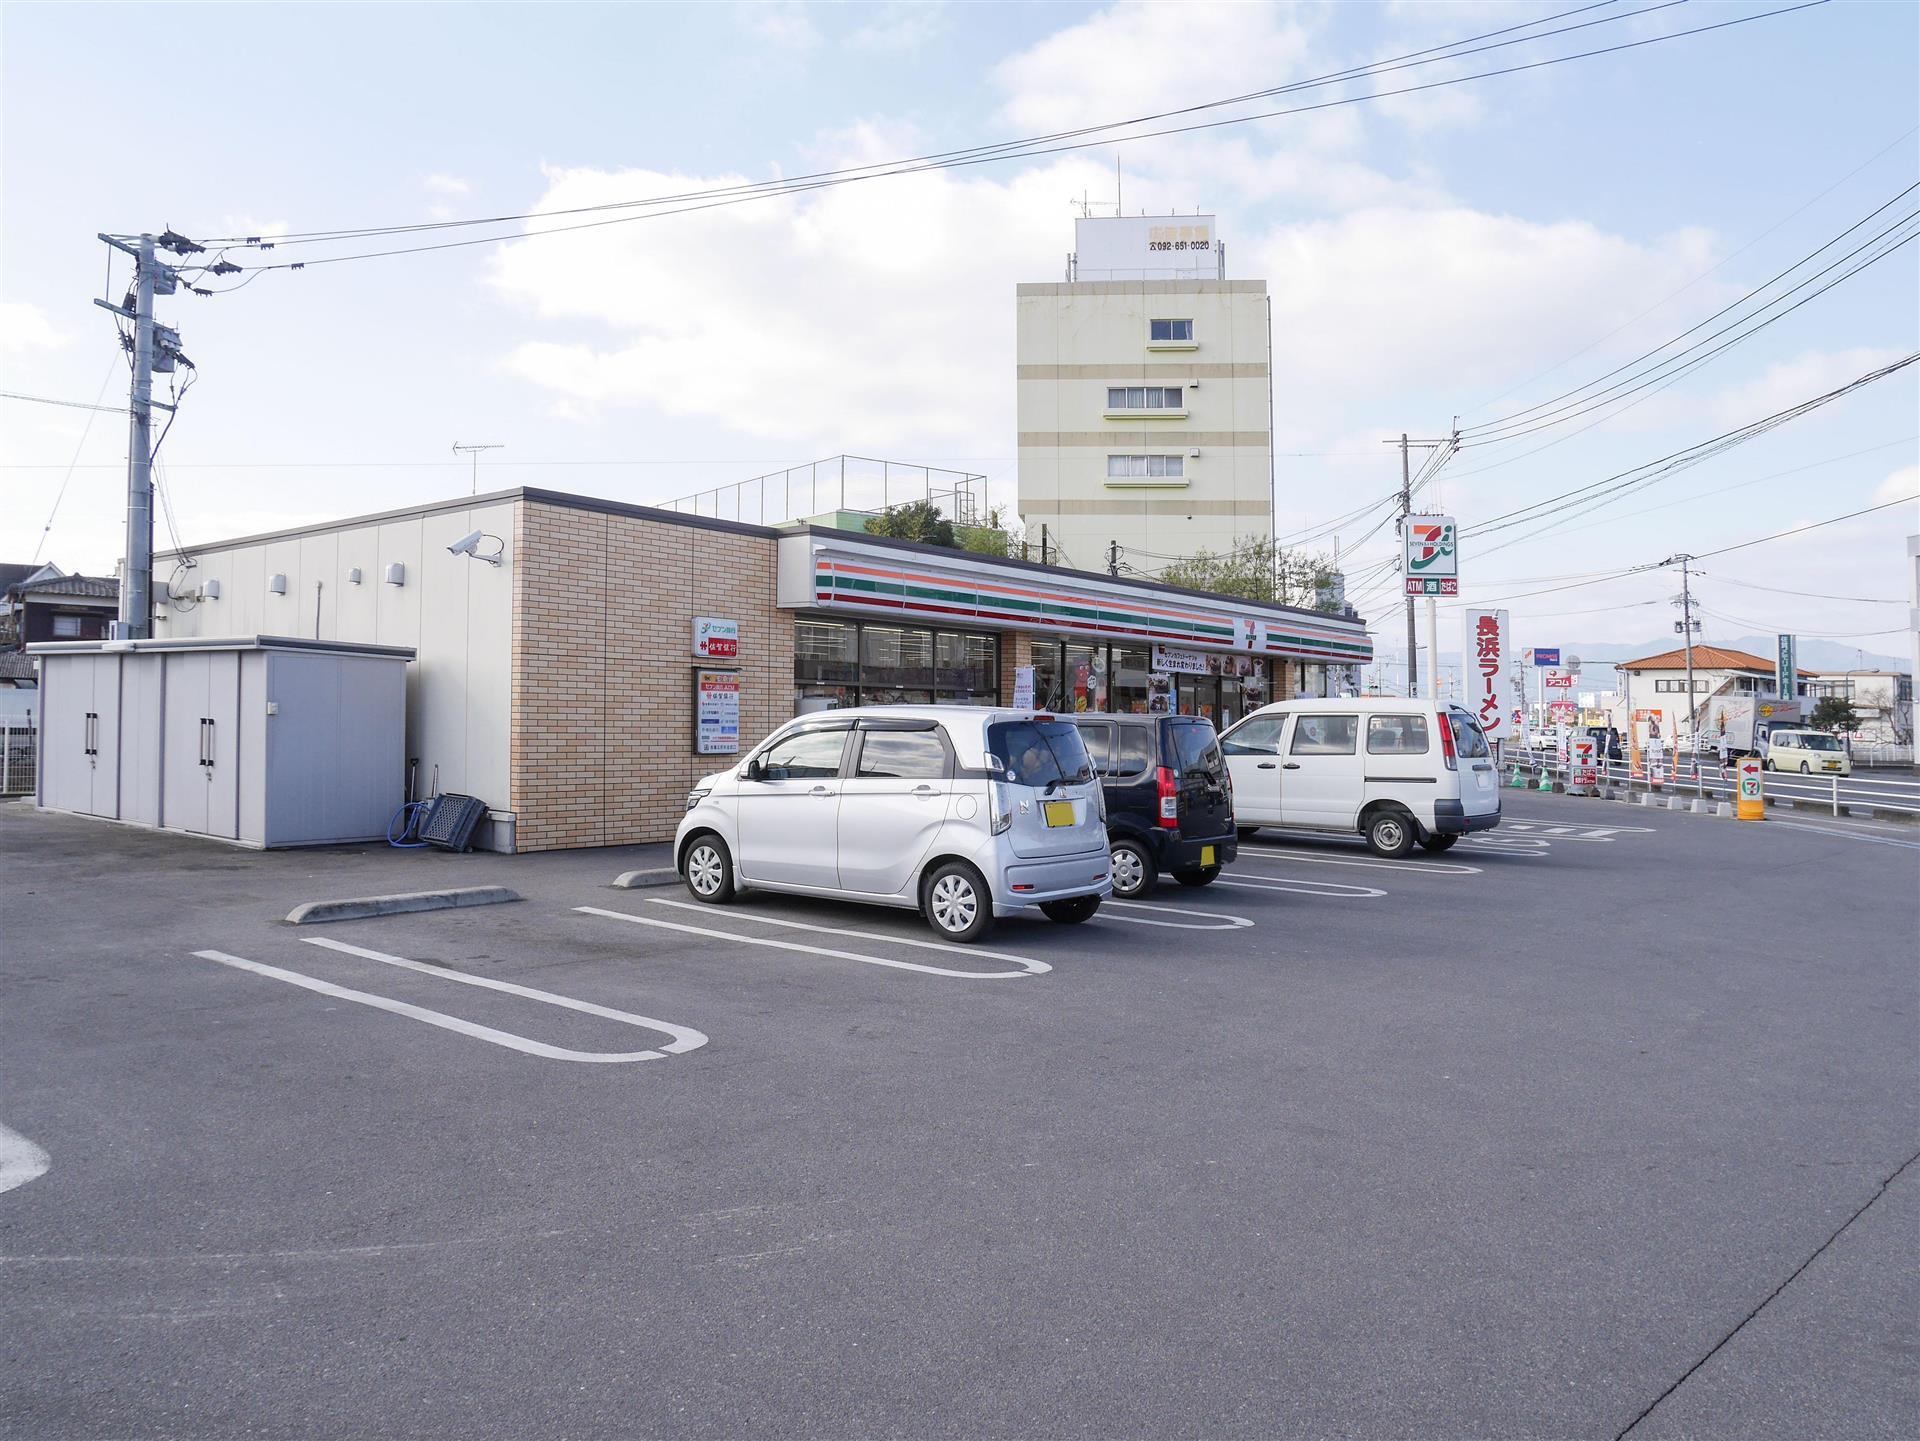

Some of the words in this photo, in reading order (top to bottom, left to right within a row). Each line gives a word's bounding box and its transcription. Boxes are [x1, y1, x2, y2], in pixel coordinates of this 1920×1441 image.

[1407, 581, 1422, 592] ATM
[1426, 581, 1437, 592] 酒
[1441, 581, 1457, 592] たばこ
[709, 642, 736, 653] 佐賀銀行
[1476, 615, 1501, 732] 長浜ラーメン
